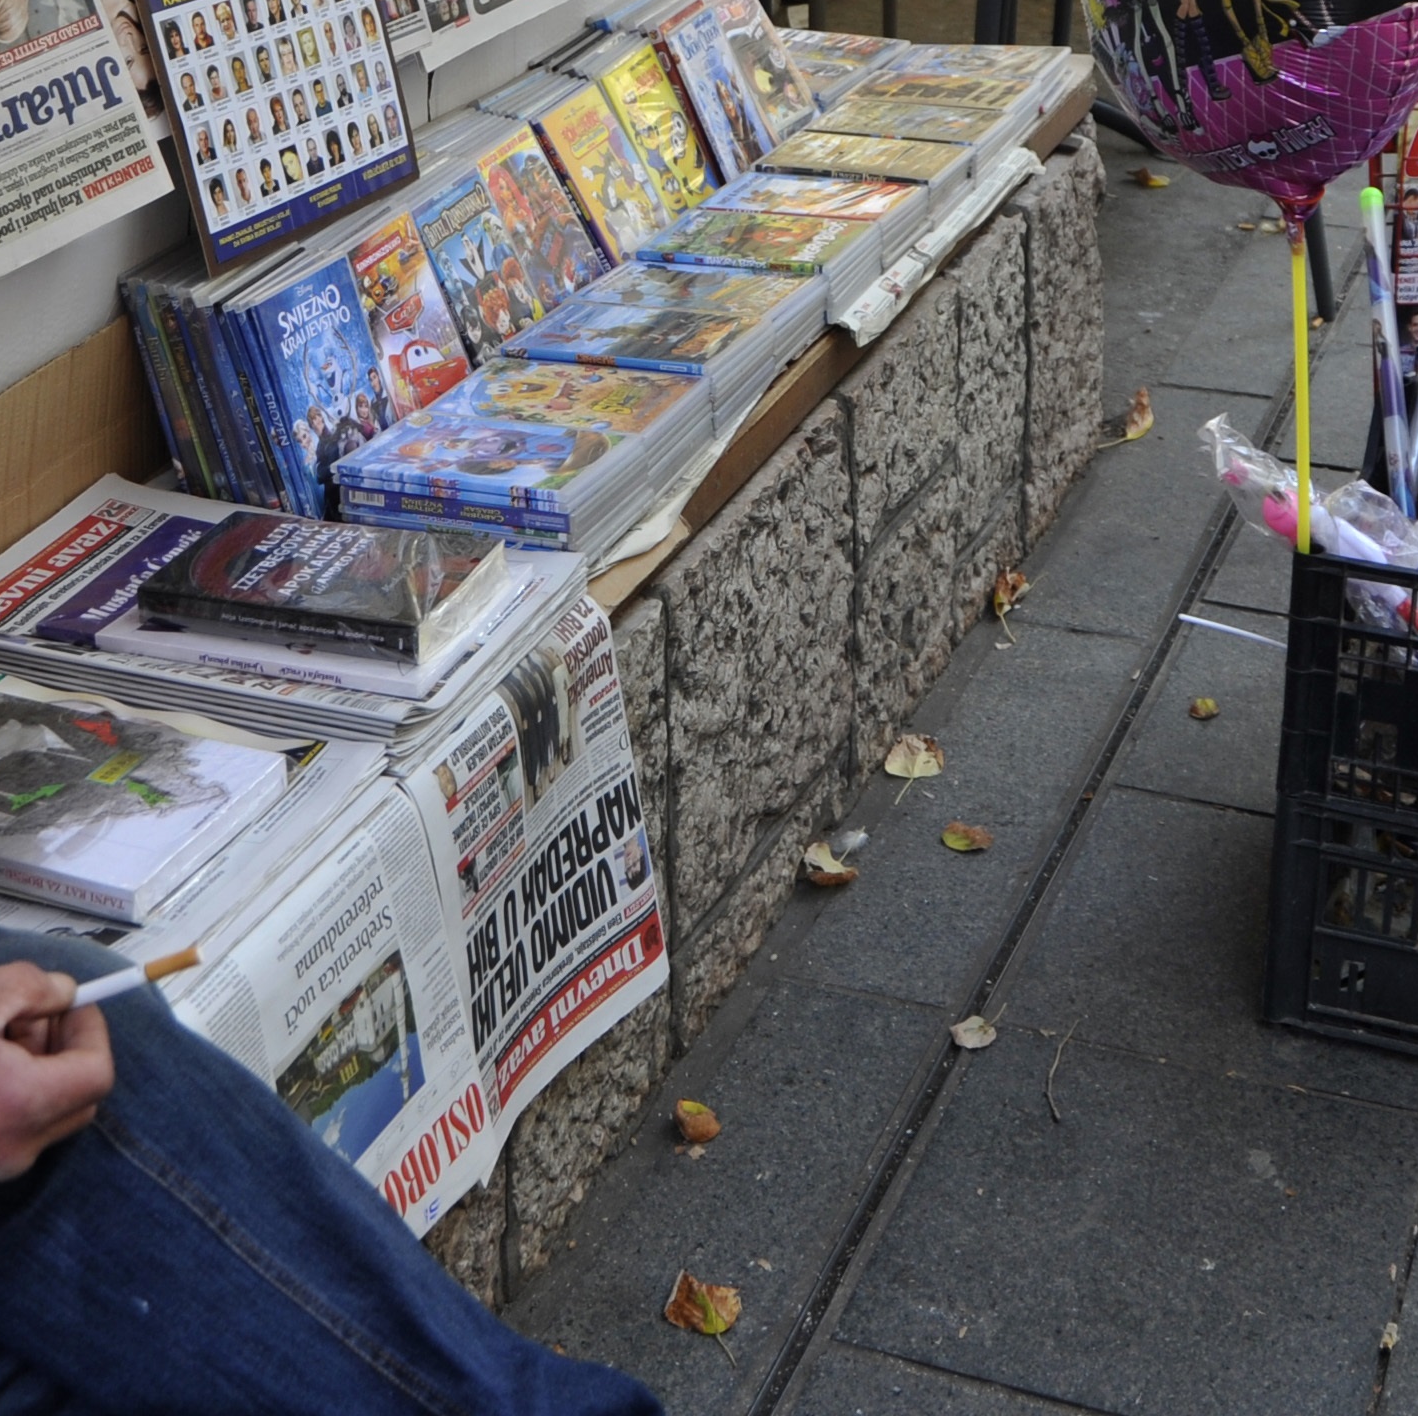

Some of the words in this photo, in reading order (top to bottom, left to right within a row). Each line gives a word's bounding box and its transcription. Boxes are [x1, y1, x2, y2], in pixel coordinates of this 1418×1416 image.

[57, 22, 81, 44] SAD
[83, 14, 99, 33] EU
[54, 155, 111, 191] skrbništvo
[112, 149, 124, 161] za
[125, 139, 147, 157] rata
[31, 183, 53, 203] nad
[57, 189, 84, 212] Kraj
[81, 155, 155, 200] BRANGELINA
[22, 198, 60, 231] ljubavi
[277, 283, 342, 339] SNJEŽNO
[280, 304, 352, 360] KRALJEVSTVO
[263, 391, 291, 448] FROZEN
[47, 522, 118, 568] avaz
[254, 522, 301, 553] ALIJA
[277, 529, 361, 597] APOKALIPSE
[79, 573, 150, 621] Mustafa
[563, 616, 608, 675] podrška
[566, 648, 614, 707] Američka
[520, 772, 641, 928] NAPREDAK
[44, 880, 62, 894] ZA
[62, 886, 87, 900] RAT
[86, 893, 126, 910] TAJNI
[294, 875, 383, 980] referenduma
[503, 888, 520, 945] U
[531, 856, 618, 976] VIDIMO
[318, 905, 393, 998] Srebrenica
[466, 908, 501, 1000] BiH
[283, 984, 318, 1036] uoči
[471, 939, 530, 1056] VELIKI
[546, 933, 645, 1034] Dnevni
[497, 1016, 547, 1086] avaz
[374, 1082, 486, 1219] OSLOBO
